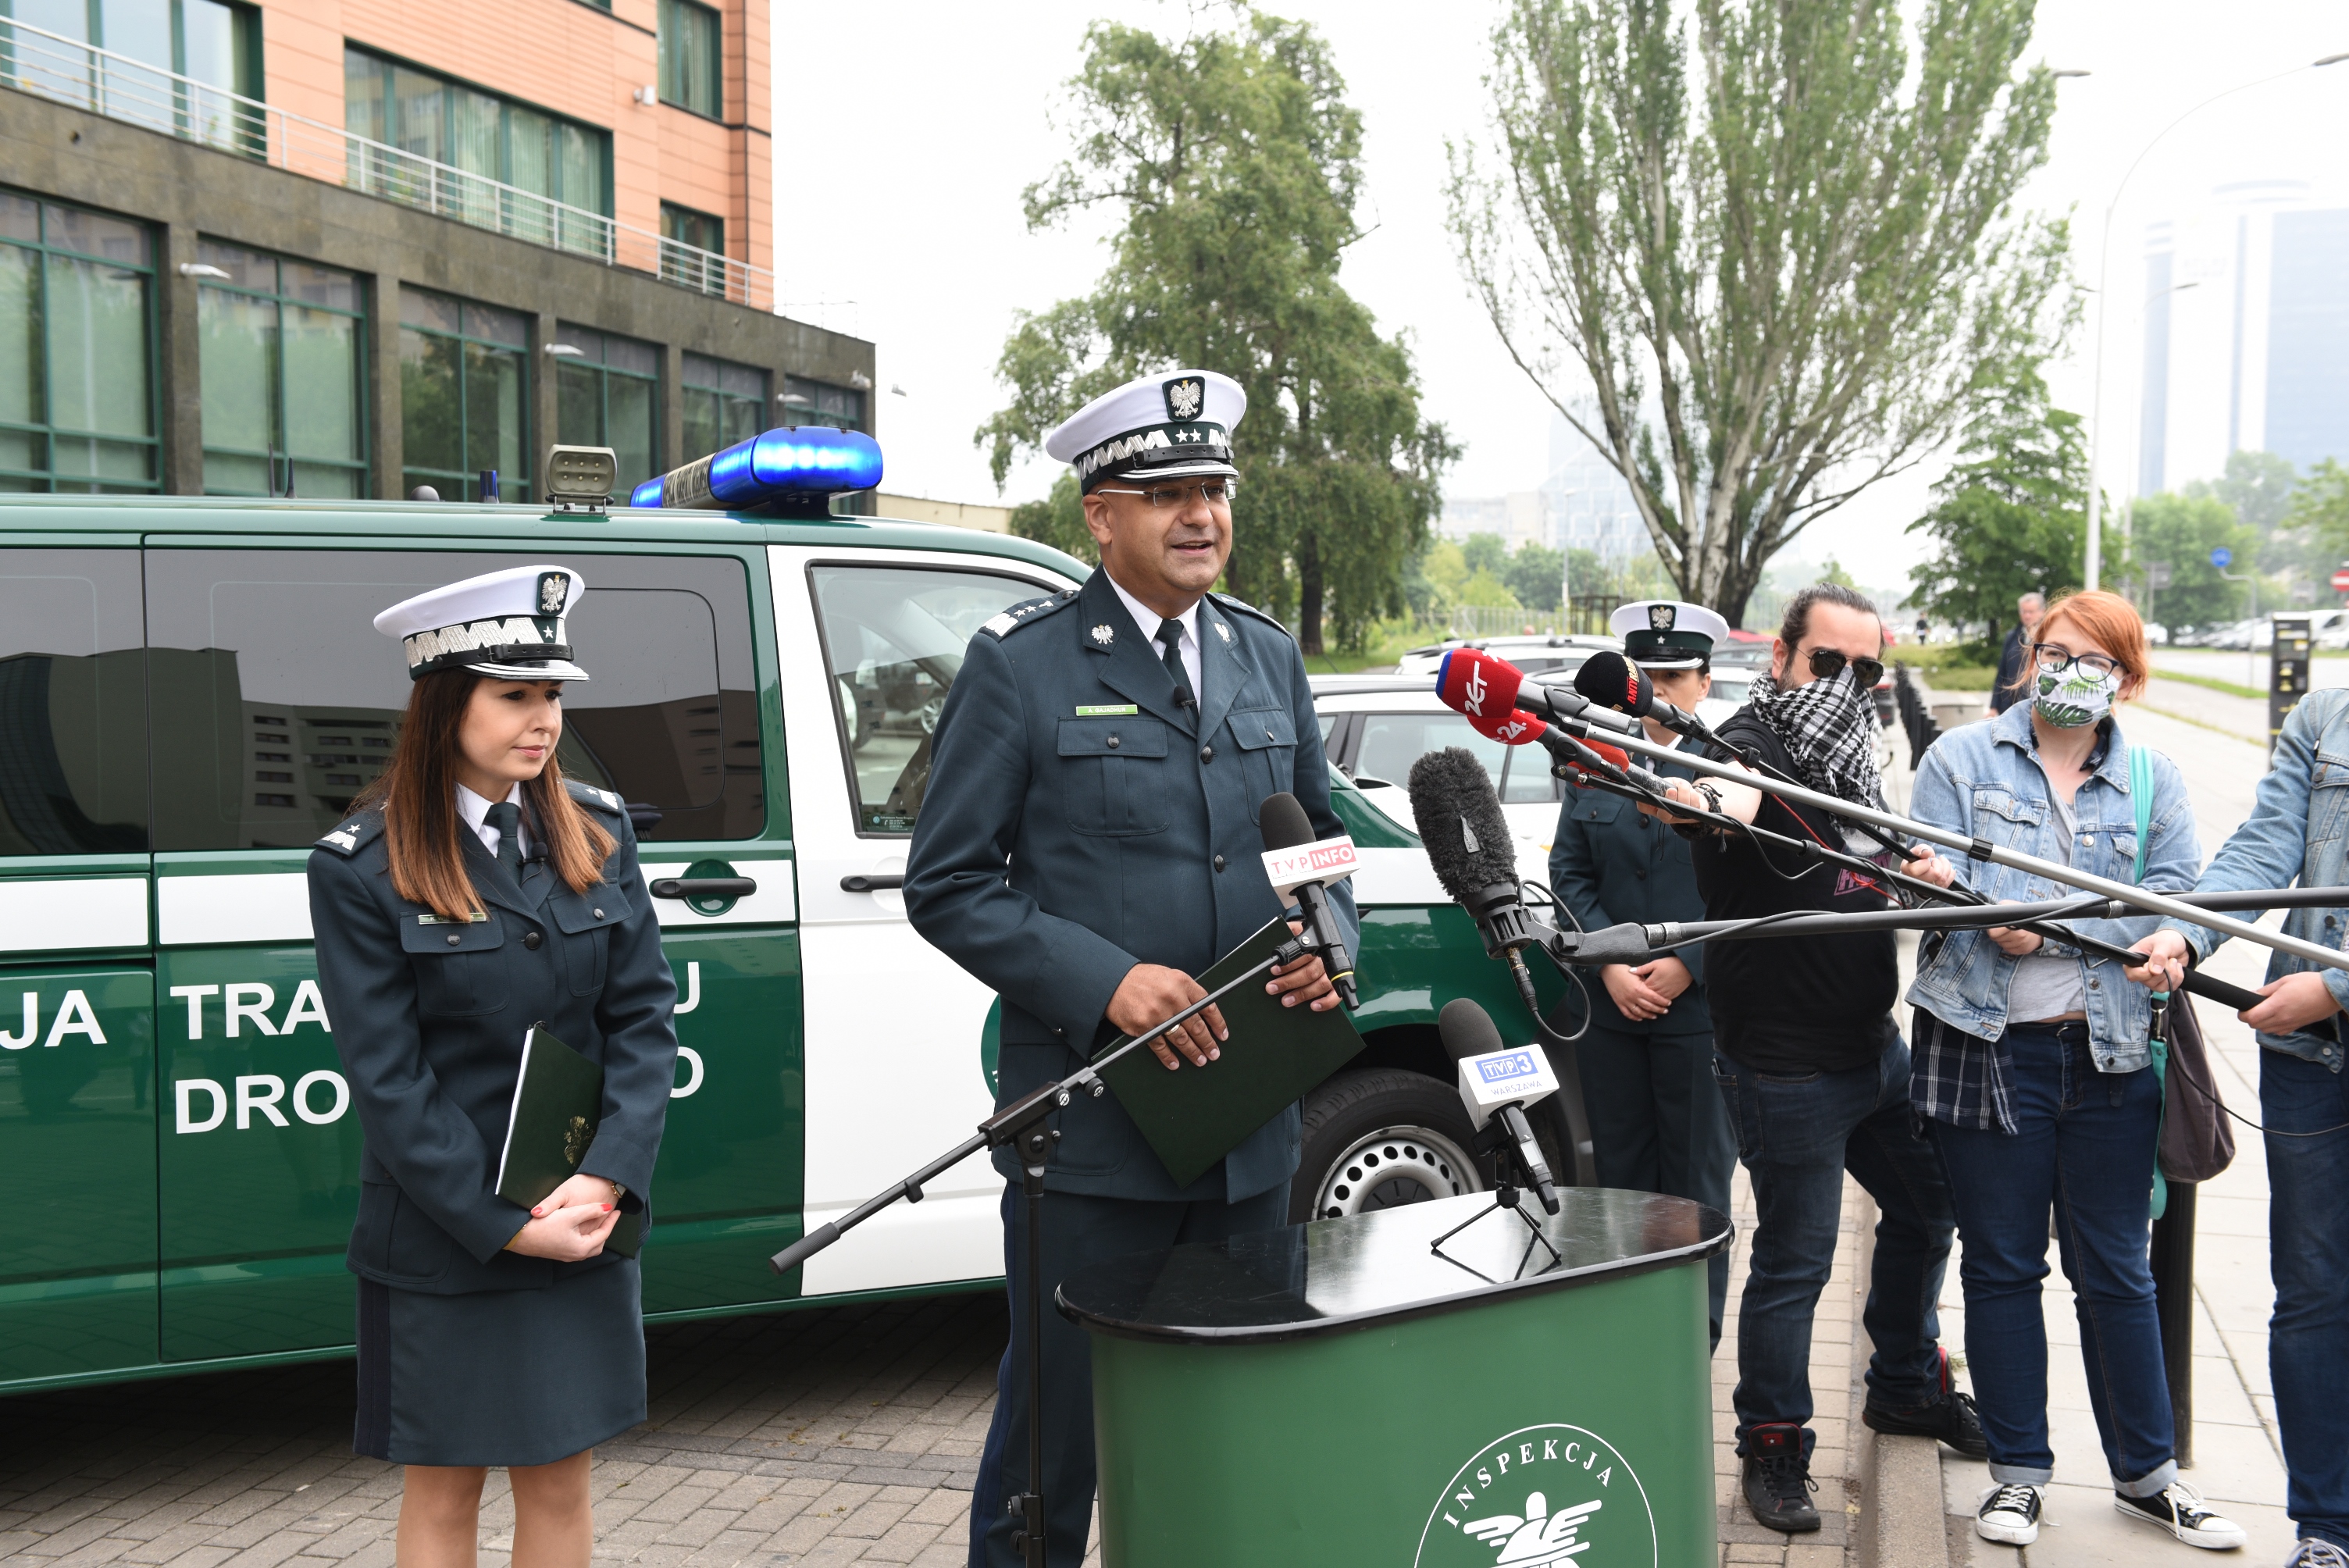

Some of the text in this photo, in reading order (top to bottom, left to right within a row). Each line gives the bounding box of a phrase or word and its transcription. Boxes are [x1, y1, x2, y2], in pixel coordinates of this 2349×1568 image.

[1271, 846, 1353, 875] TVP INFO
[1490, 1080, 1543, 1096] WARSZAWA
[1442, 1439, 1613, 1528] INSPEKCJA
